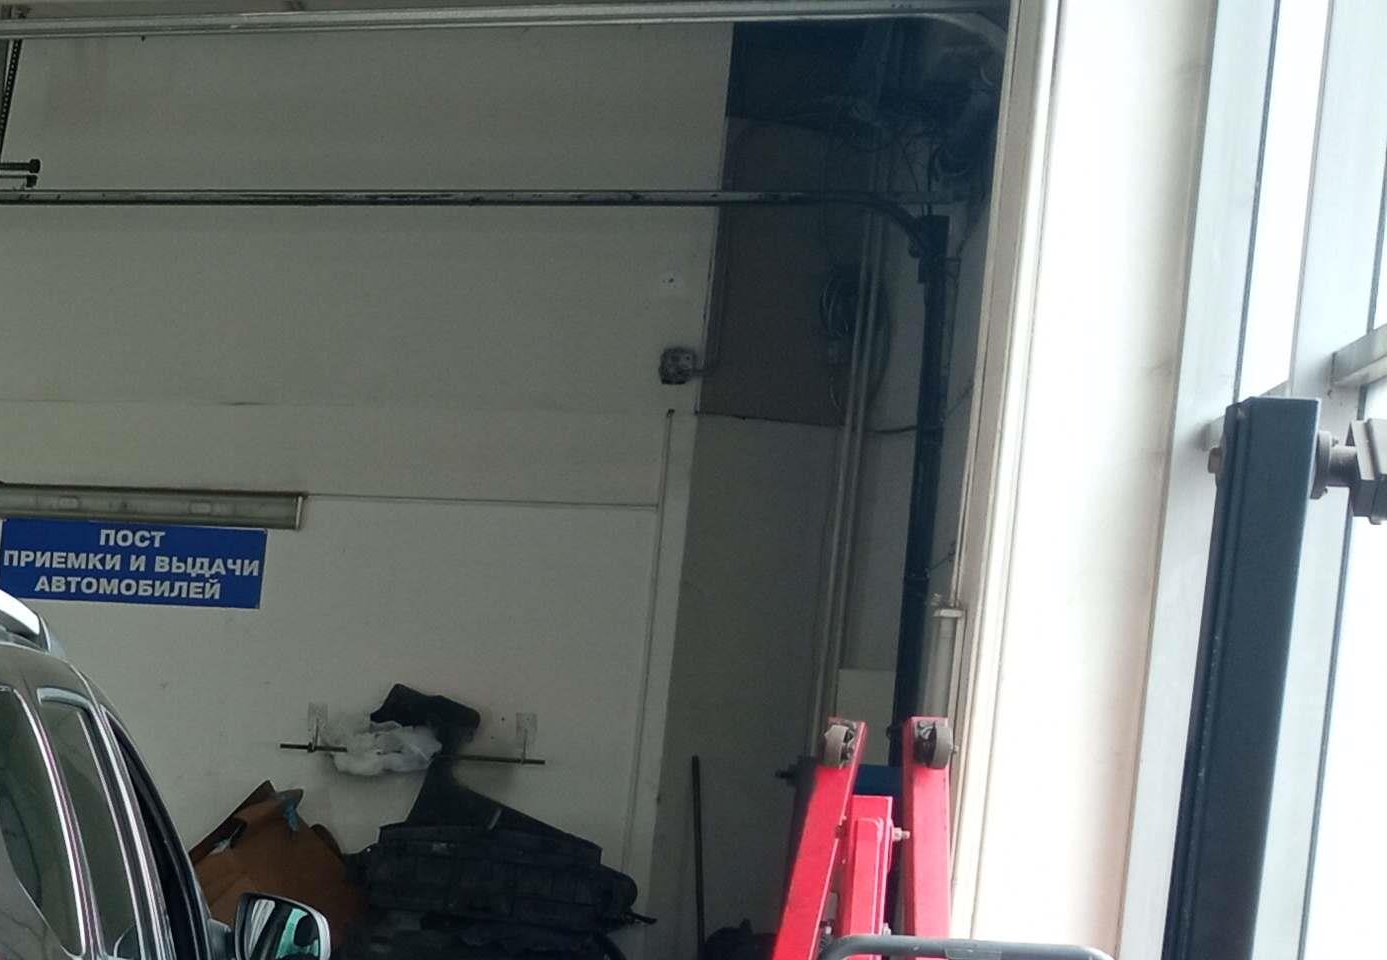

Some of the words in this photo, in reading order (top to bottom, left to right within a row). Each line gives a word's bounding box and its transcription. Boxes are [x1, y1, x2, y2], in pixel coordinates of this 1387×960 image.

[100, 529, 165, 548] ПОСТ
[4, 550, 121, 571] ПРИЕМКИ
[130, 555, 145, 572] И
[155, 556, 259, 577] ВЫДАЧИ
[34, 575, 221, 600] АВТОМОБИЛЕЙ
